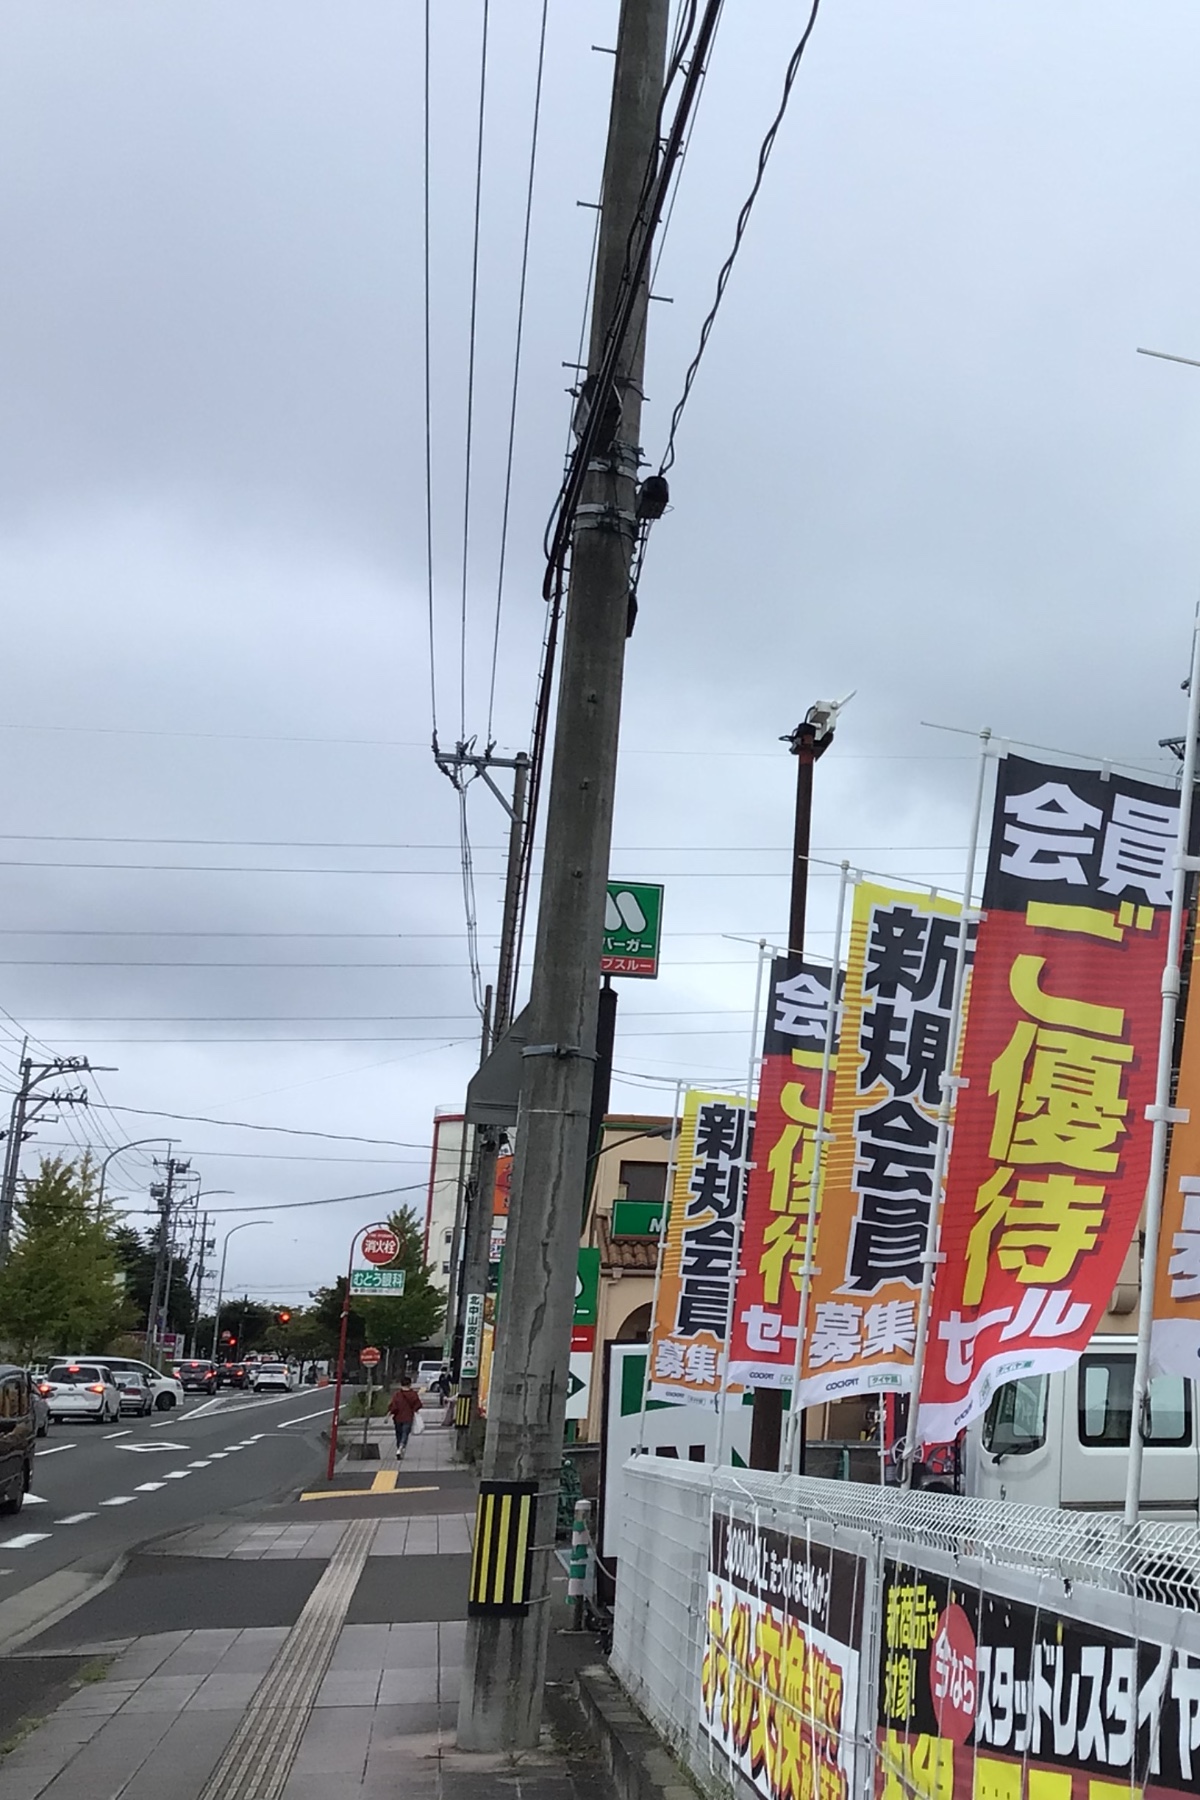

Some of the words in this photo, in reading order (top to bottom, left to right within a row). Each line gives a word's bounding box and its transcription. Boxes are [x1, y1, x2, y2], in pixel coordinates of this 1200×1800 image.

[1000, 782, 1181, 904] 会員
[849, 907, 976, 1292] 新規会員
[962, 901, 1155, 1307] ご優待
[353, 1272, 403, 1287] むとう眼科
[364, 1240, 396, 1255] 消火栓
[809, 1301, 929, 1370] 募集
[932, 1627, 975, 1715] 今なら
